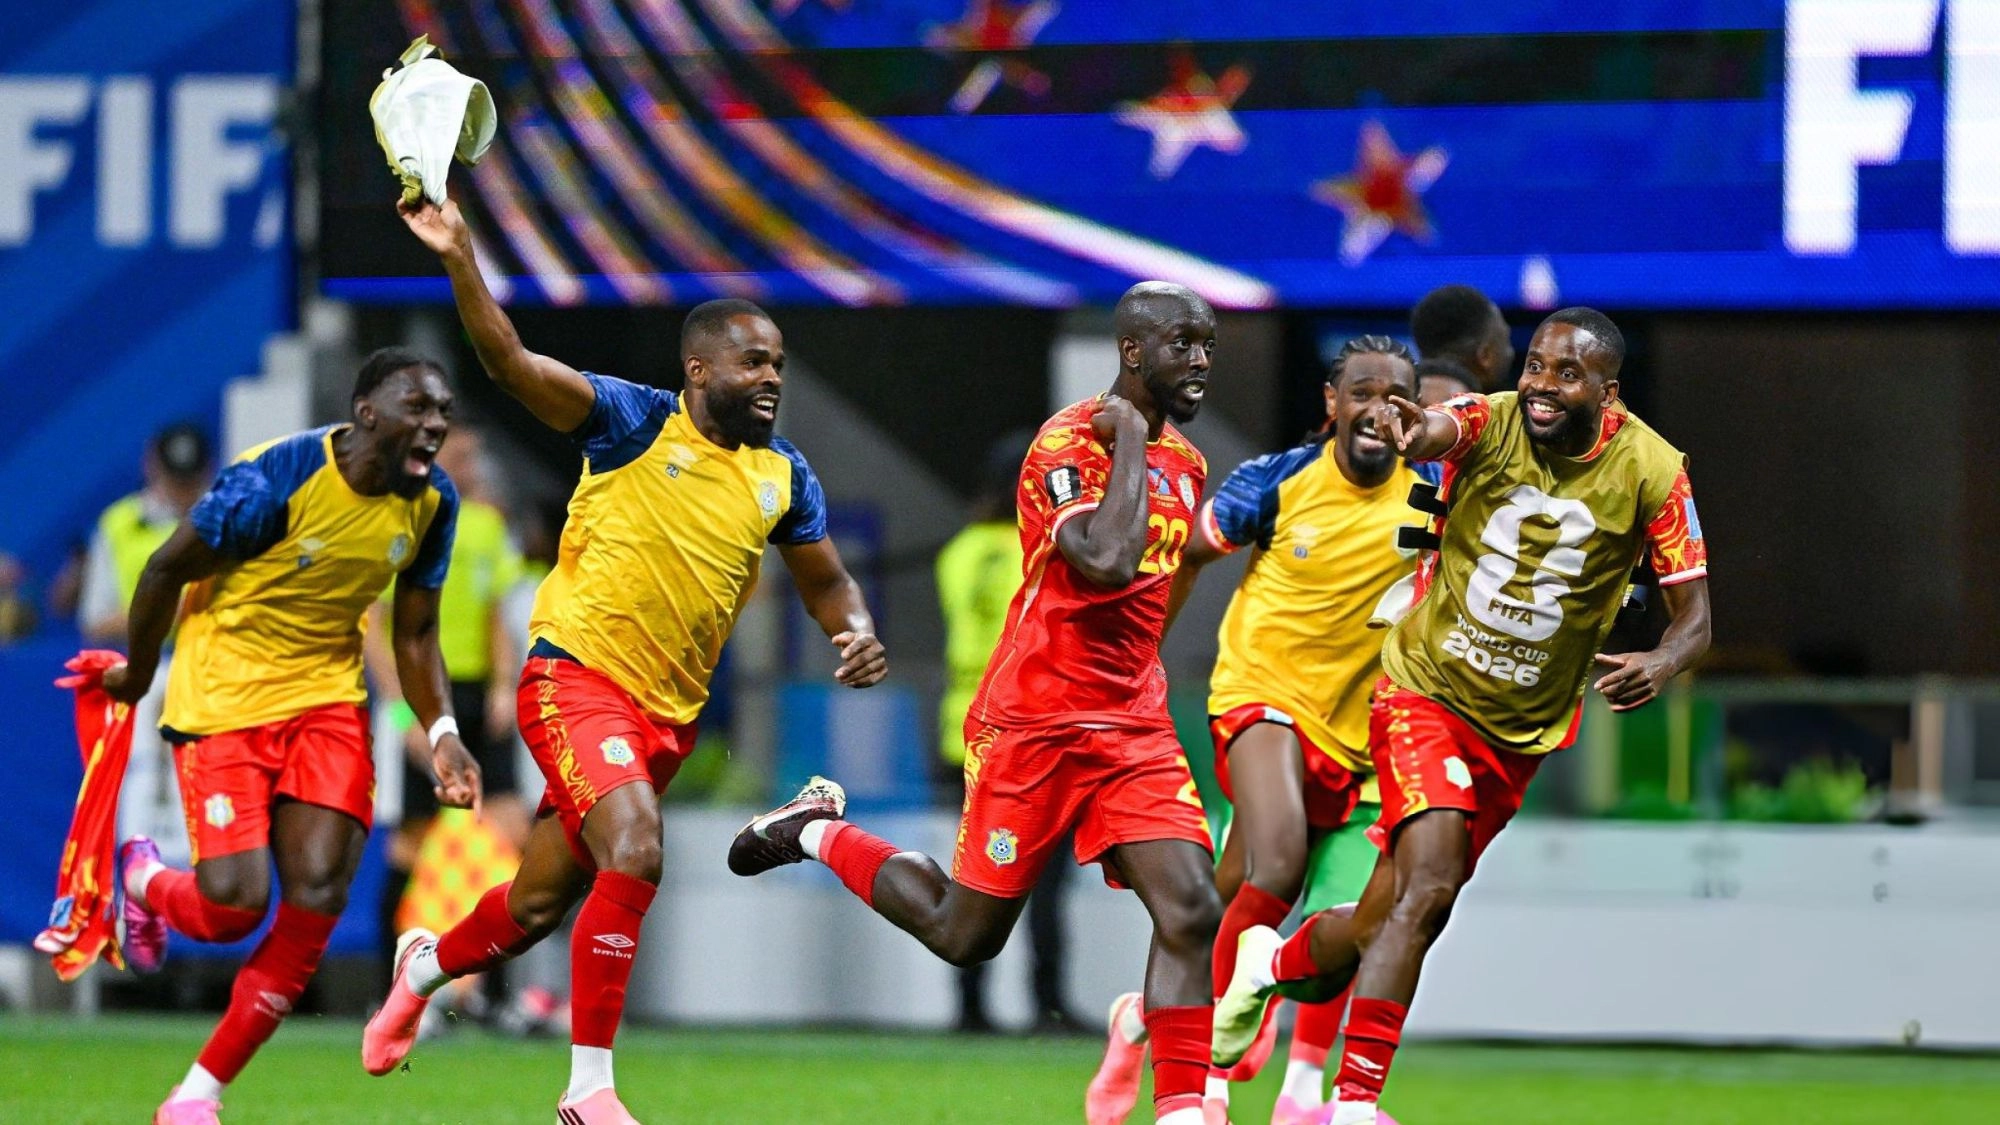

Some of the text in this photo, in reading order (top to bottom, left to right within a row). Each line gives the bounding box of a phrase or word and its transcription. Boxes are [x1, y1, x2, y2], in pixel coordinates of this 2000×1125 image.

[1137, 513, 1188, 575] 20
[1456, 613, 1550, 663] WORLD CUP
[1487, 598, 1534, 626] FIFA
[1440, 630, 1542, 688] 2026
